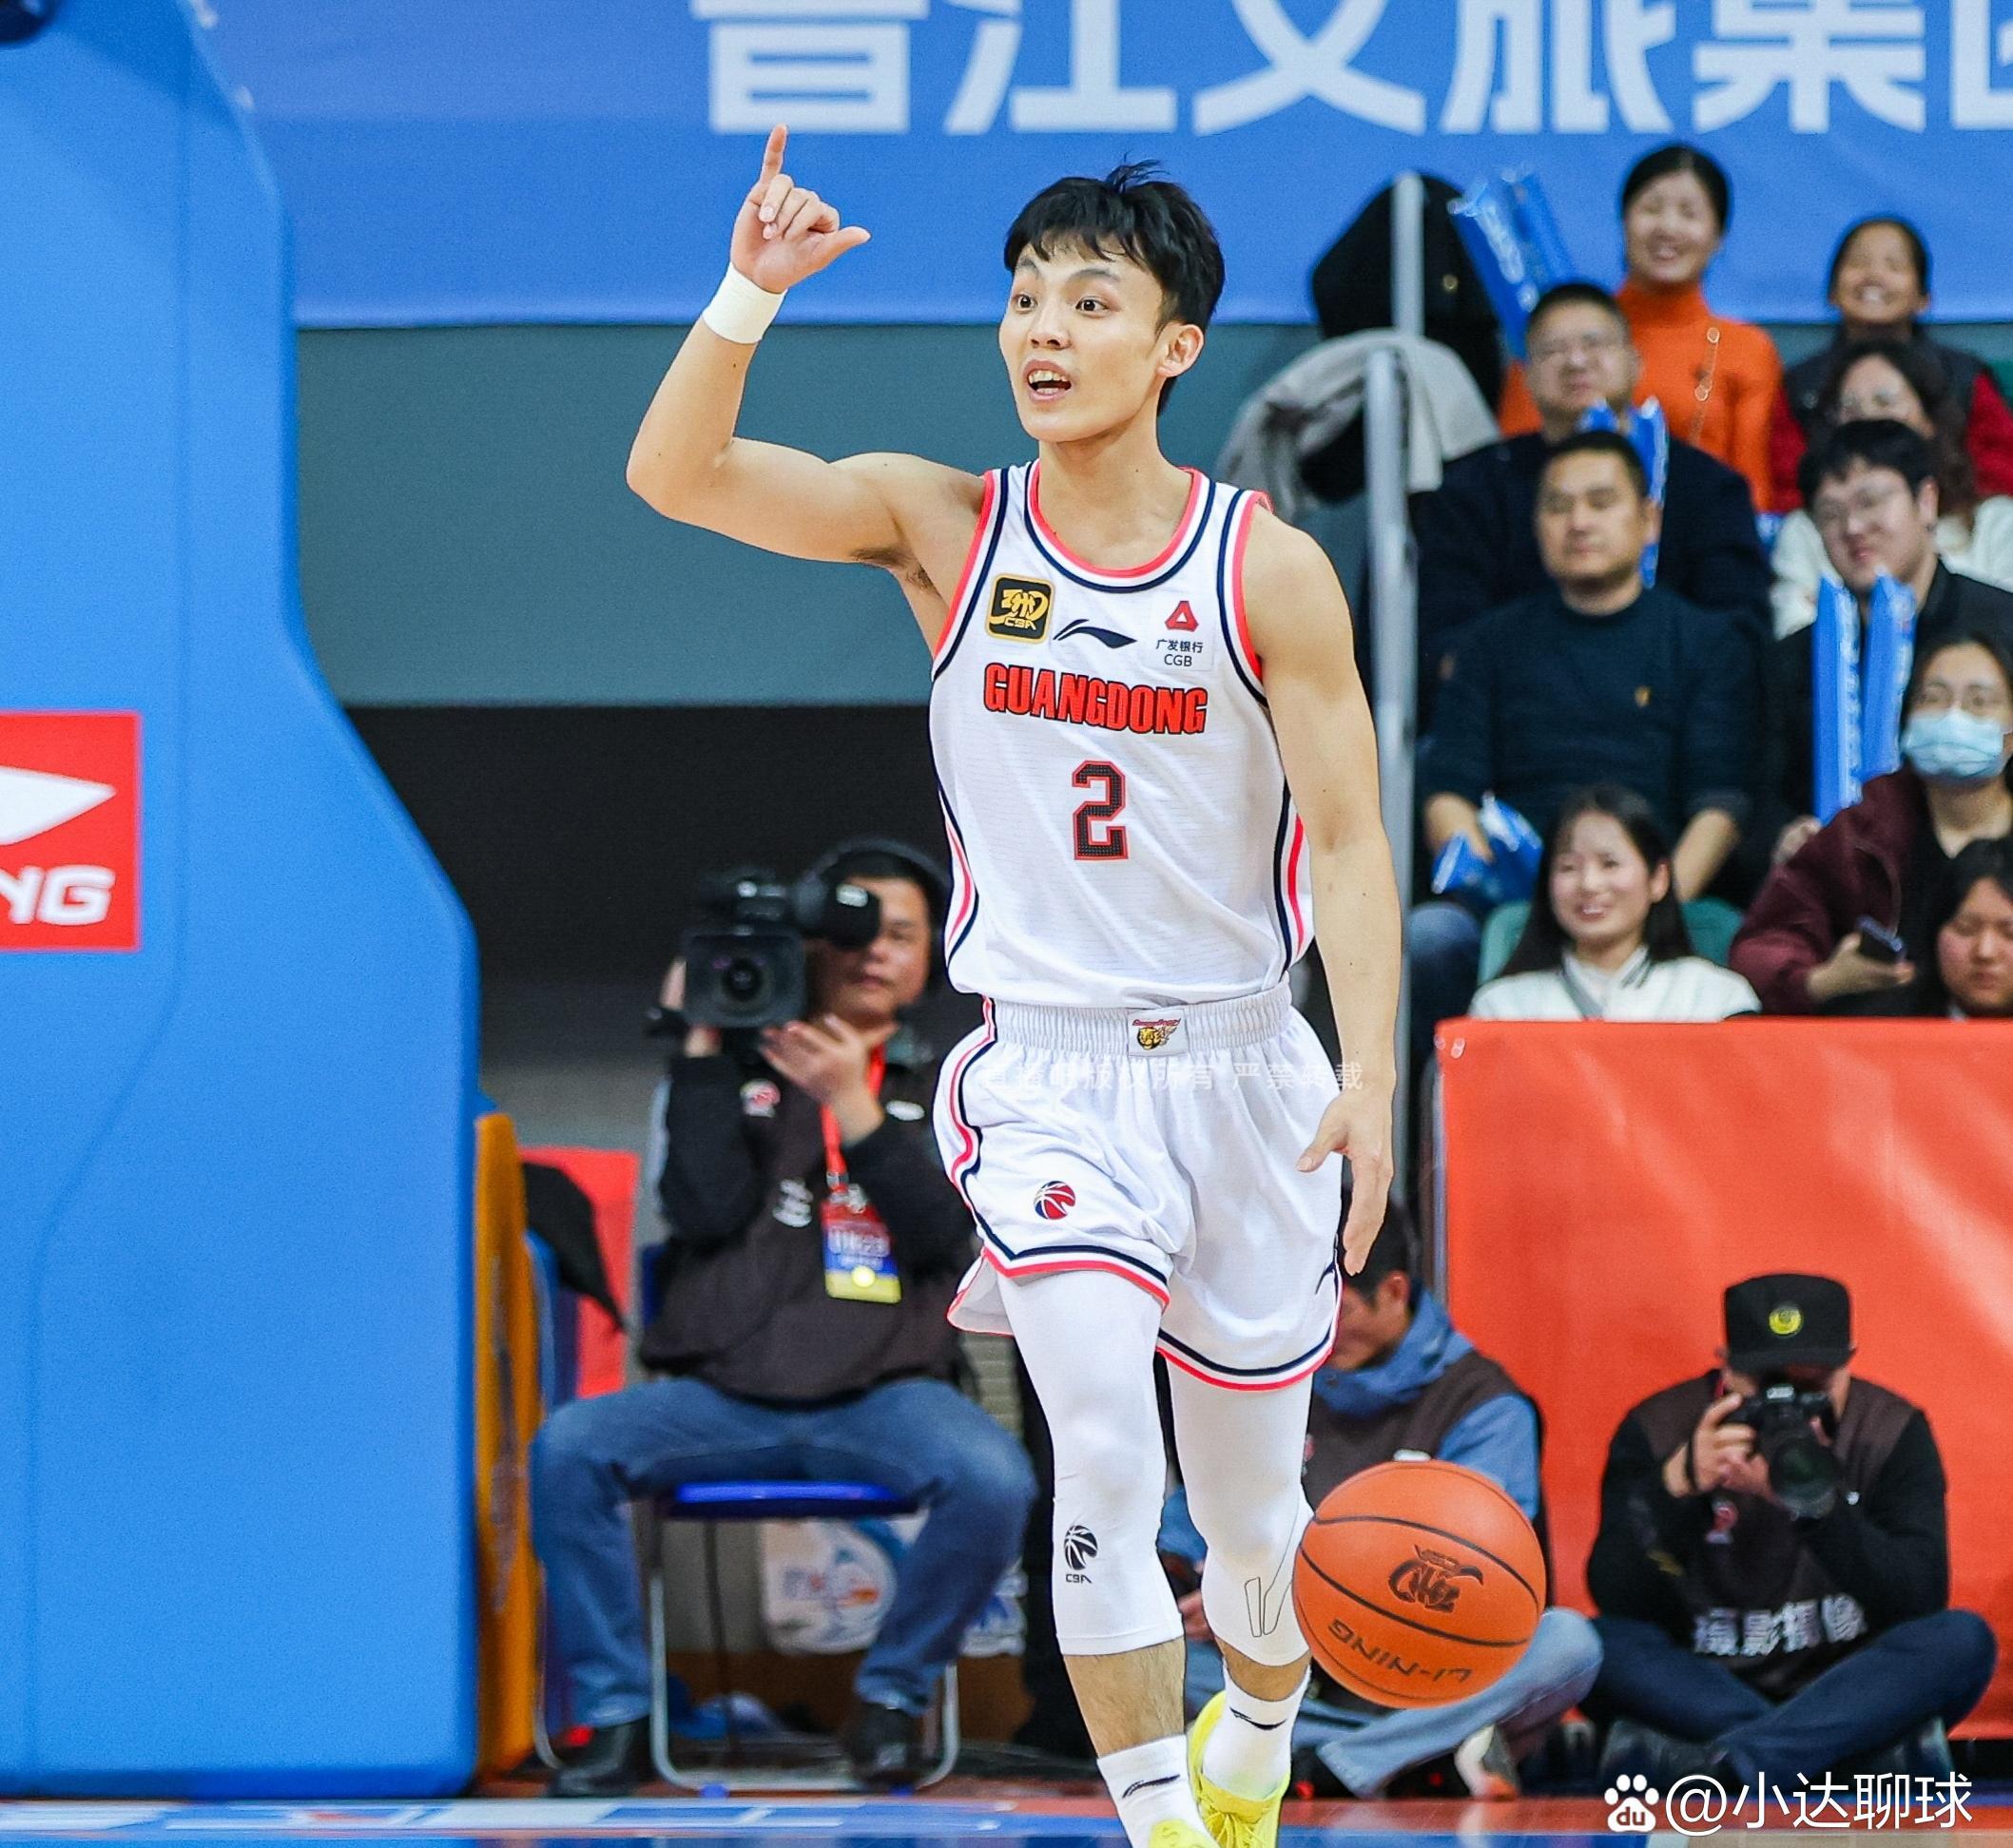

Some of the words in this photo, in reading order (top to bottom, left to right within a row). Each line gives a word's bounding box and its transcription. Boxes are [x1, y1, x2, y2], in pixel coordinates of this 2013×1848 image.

[1004, 616, 1037, 631] CBA
[1155, 638, 1204, 654] 广发银行
[1164, 653, 1192, 667] CGB
[983, 663, 1209, 735] GUANGDONG
[1071, 760, 1129, 860] 2
[1065, 1573, 1093, 1585] CBA
[1327, 1618, 1473, 1683] LI-NING
